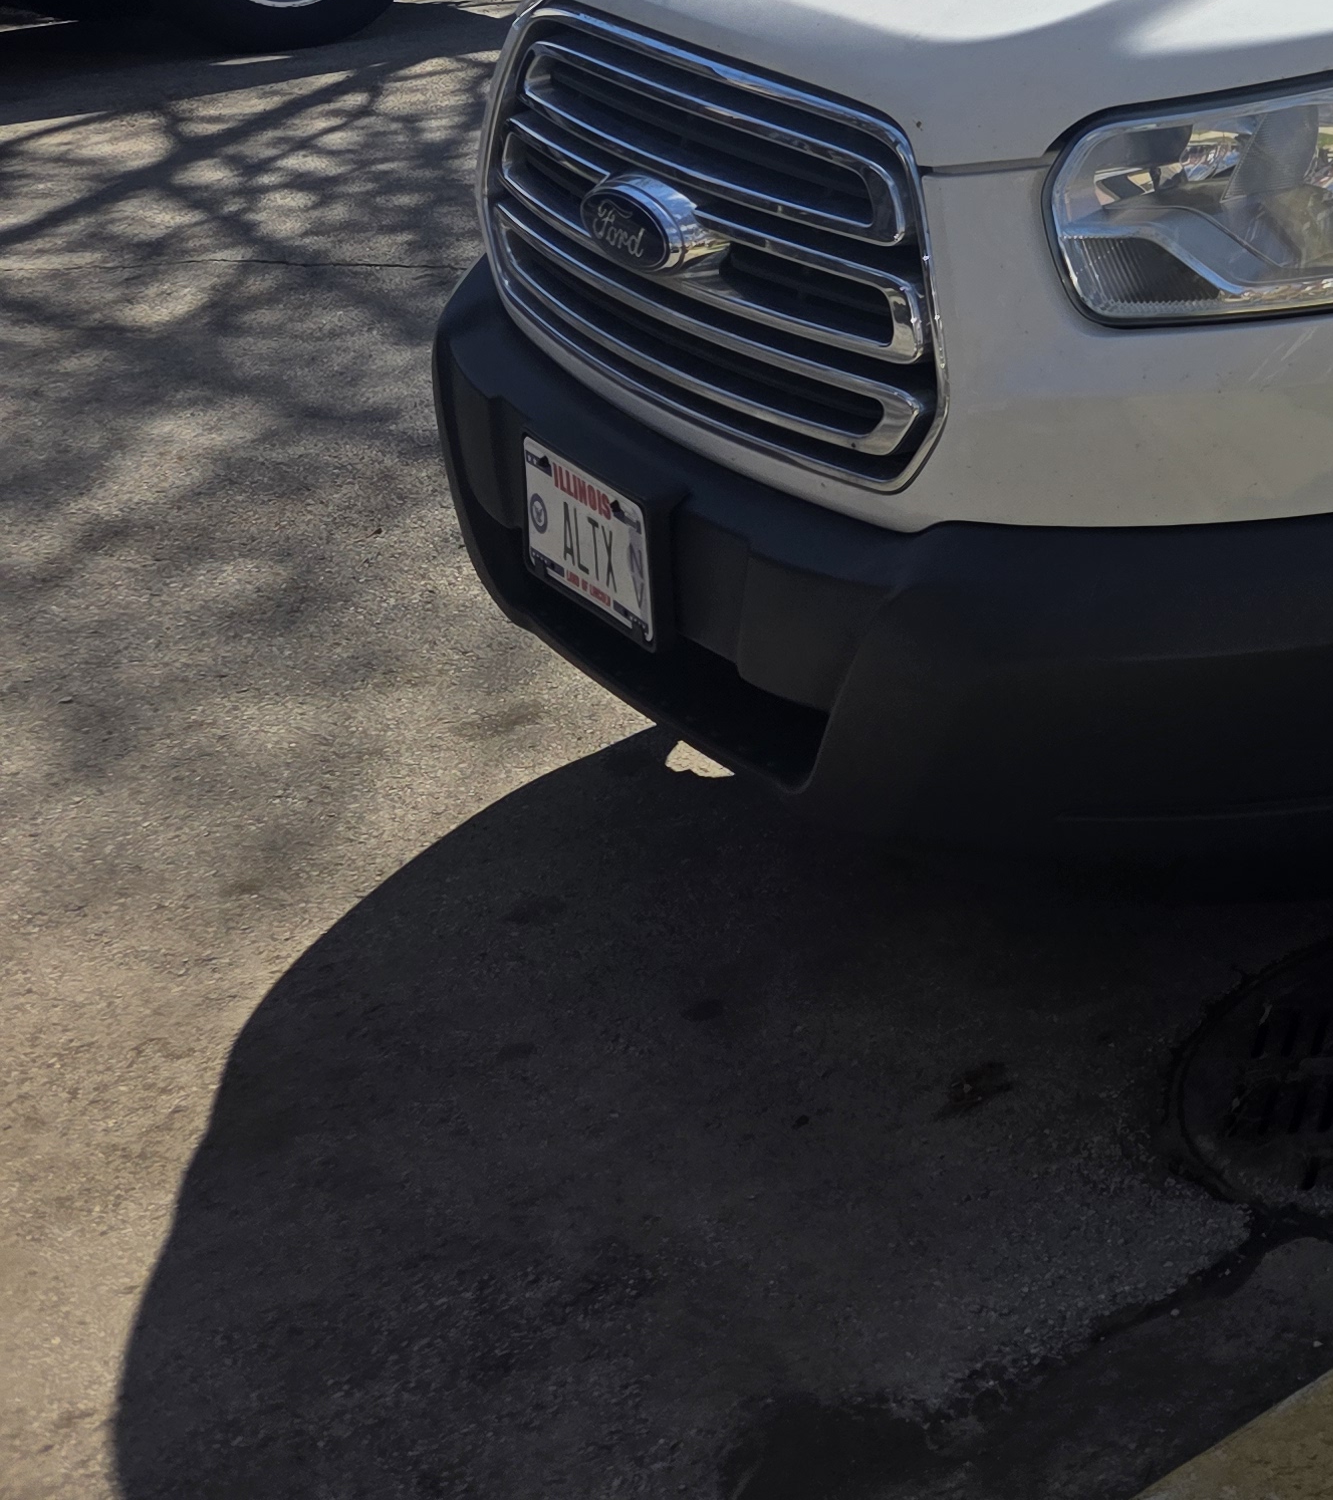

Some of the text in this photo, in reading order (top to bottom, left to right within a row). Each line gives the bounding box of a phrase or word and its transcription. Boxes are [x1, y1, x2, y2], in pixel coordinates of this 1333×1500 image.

[592, 198, 646, 258] Ford
[552, 462, 611, 520] ILLINOIS
[563, 501, 617, 593] ALTX
